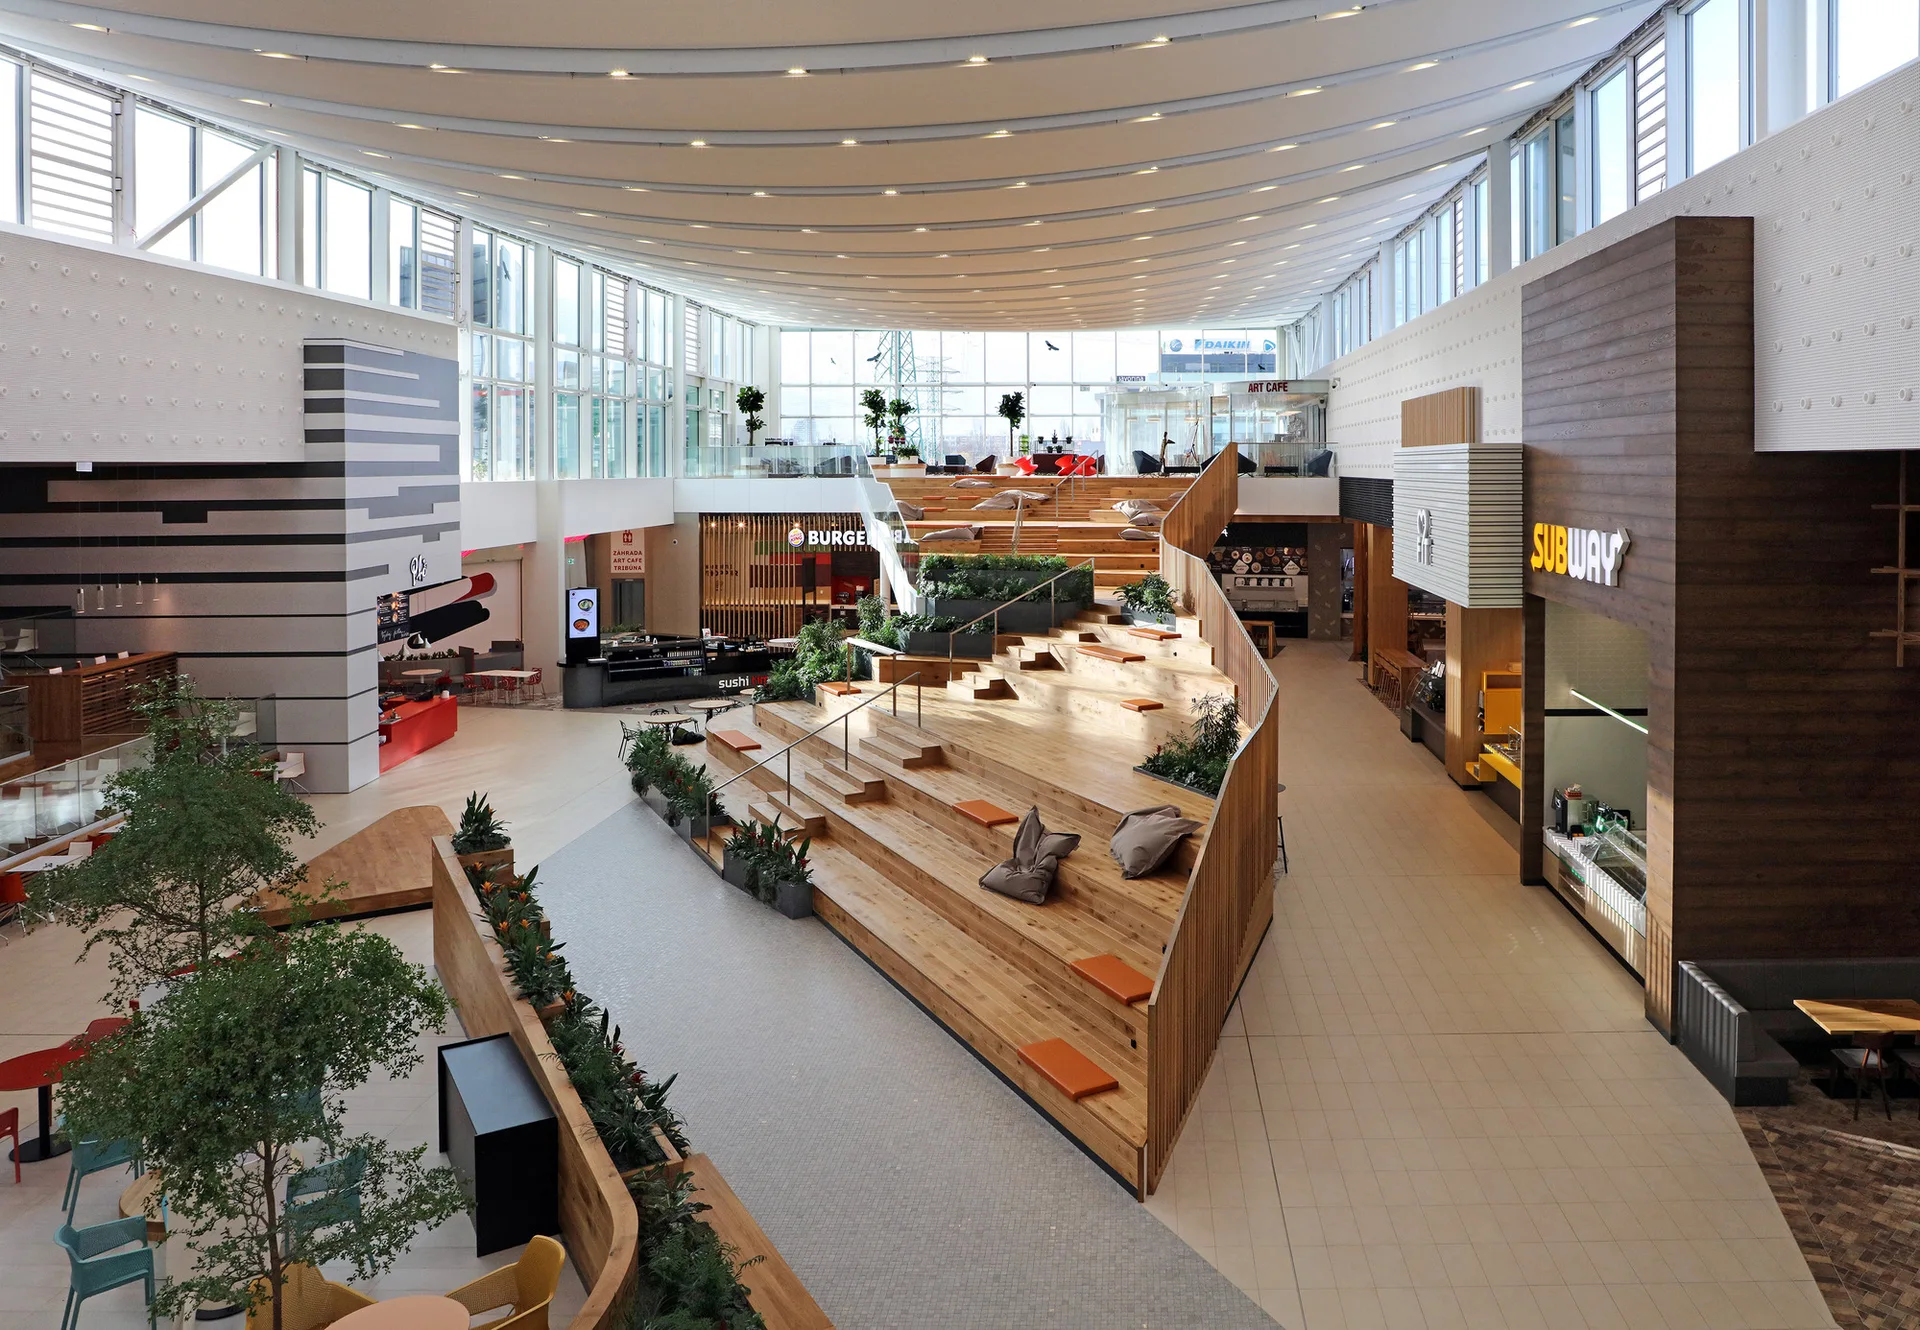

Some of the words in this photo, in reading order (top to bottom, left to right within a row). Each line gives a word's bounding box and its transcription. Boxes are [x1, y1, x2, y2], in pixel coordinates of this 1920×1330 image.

[1204, 340, 1250, 349] DAIKIN
[1248, 383, 1263, 393] ART
[1266, 382, 1288, 392] CAFE
[808, 530, 872, 545] BURGE
[1530, 522, 1627, 587] SUBWAY
[718, 676, 749, 689] sushi
